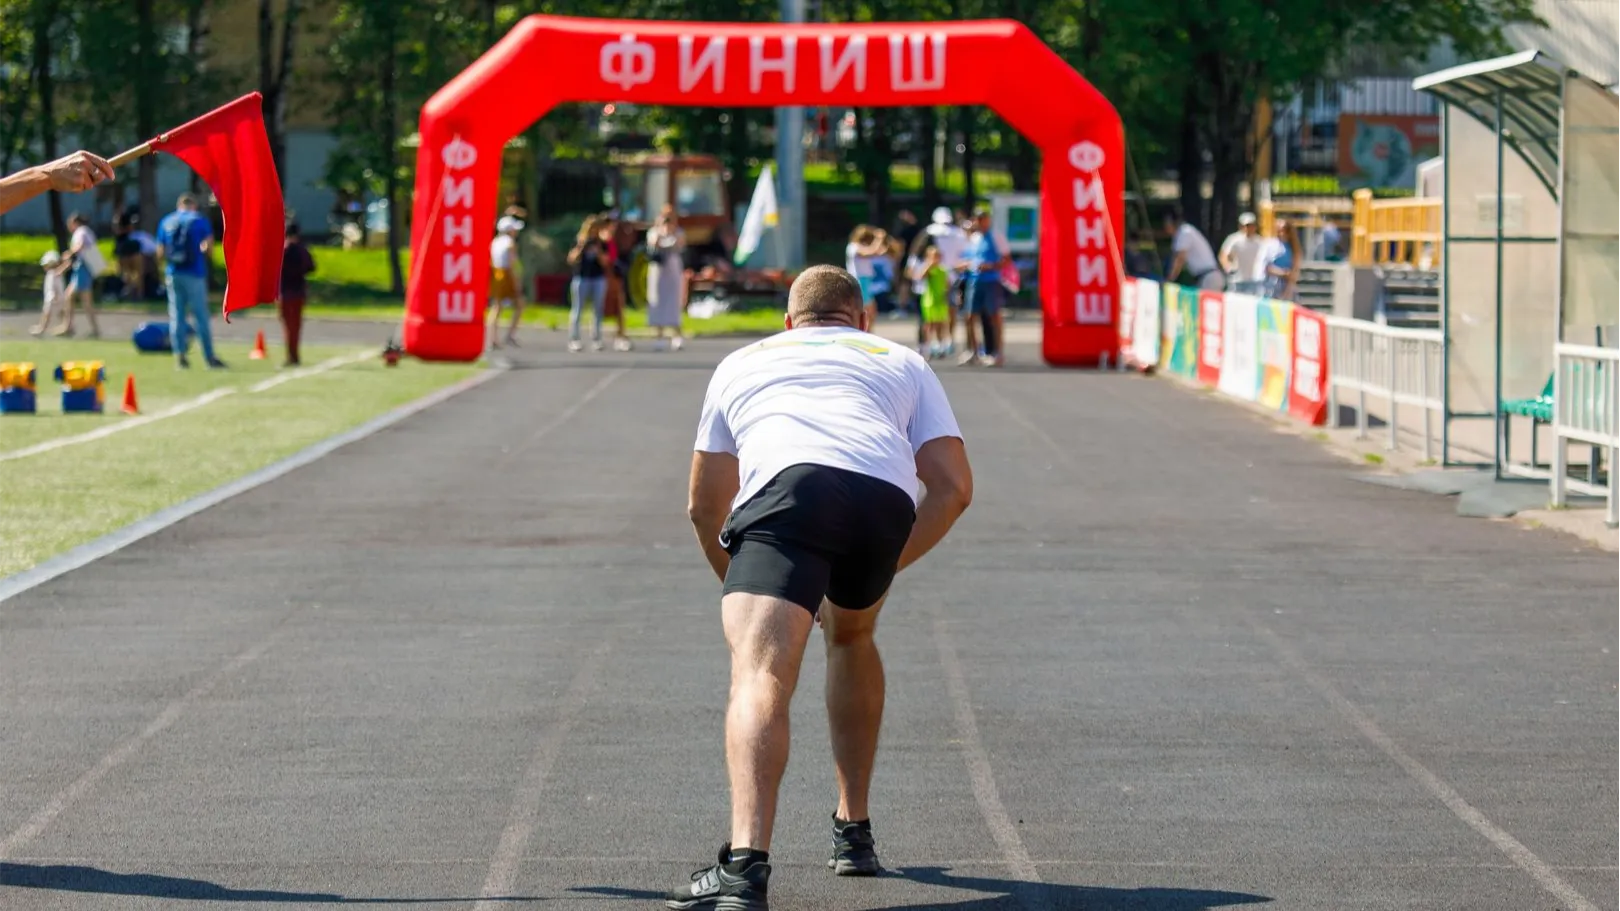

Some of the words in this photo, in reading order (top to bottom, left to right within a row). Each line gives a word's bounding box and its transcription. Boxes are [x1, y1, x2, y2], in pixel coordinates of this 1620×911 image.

[599, 32, 947, 92] ФИНИШ
[438, 138, 478, 322] ФИНИШ
[1068, 141, 1111, 324] ФИНИШ
